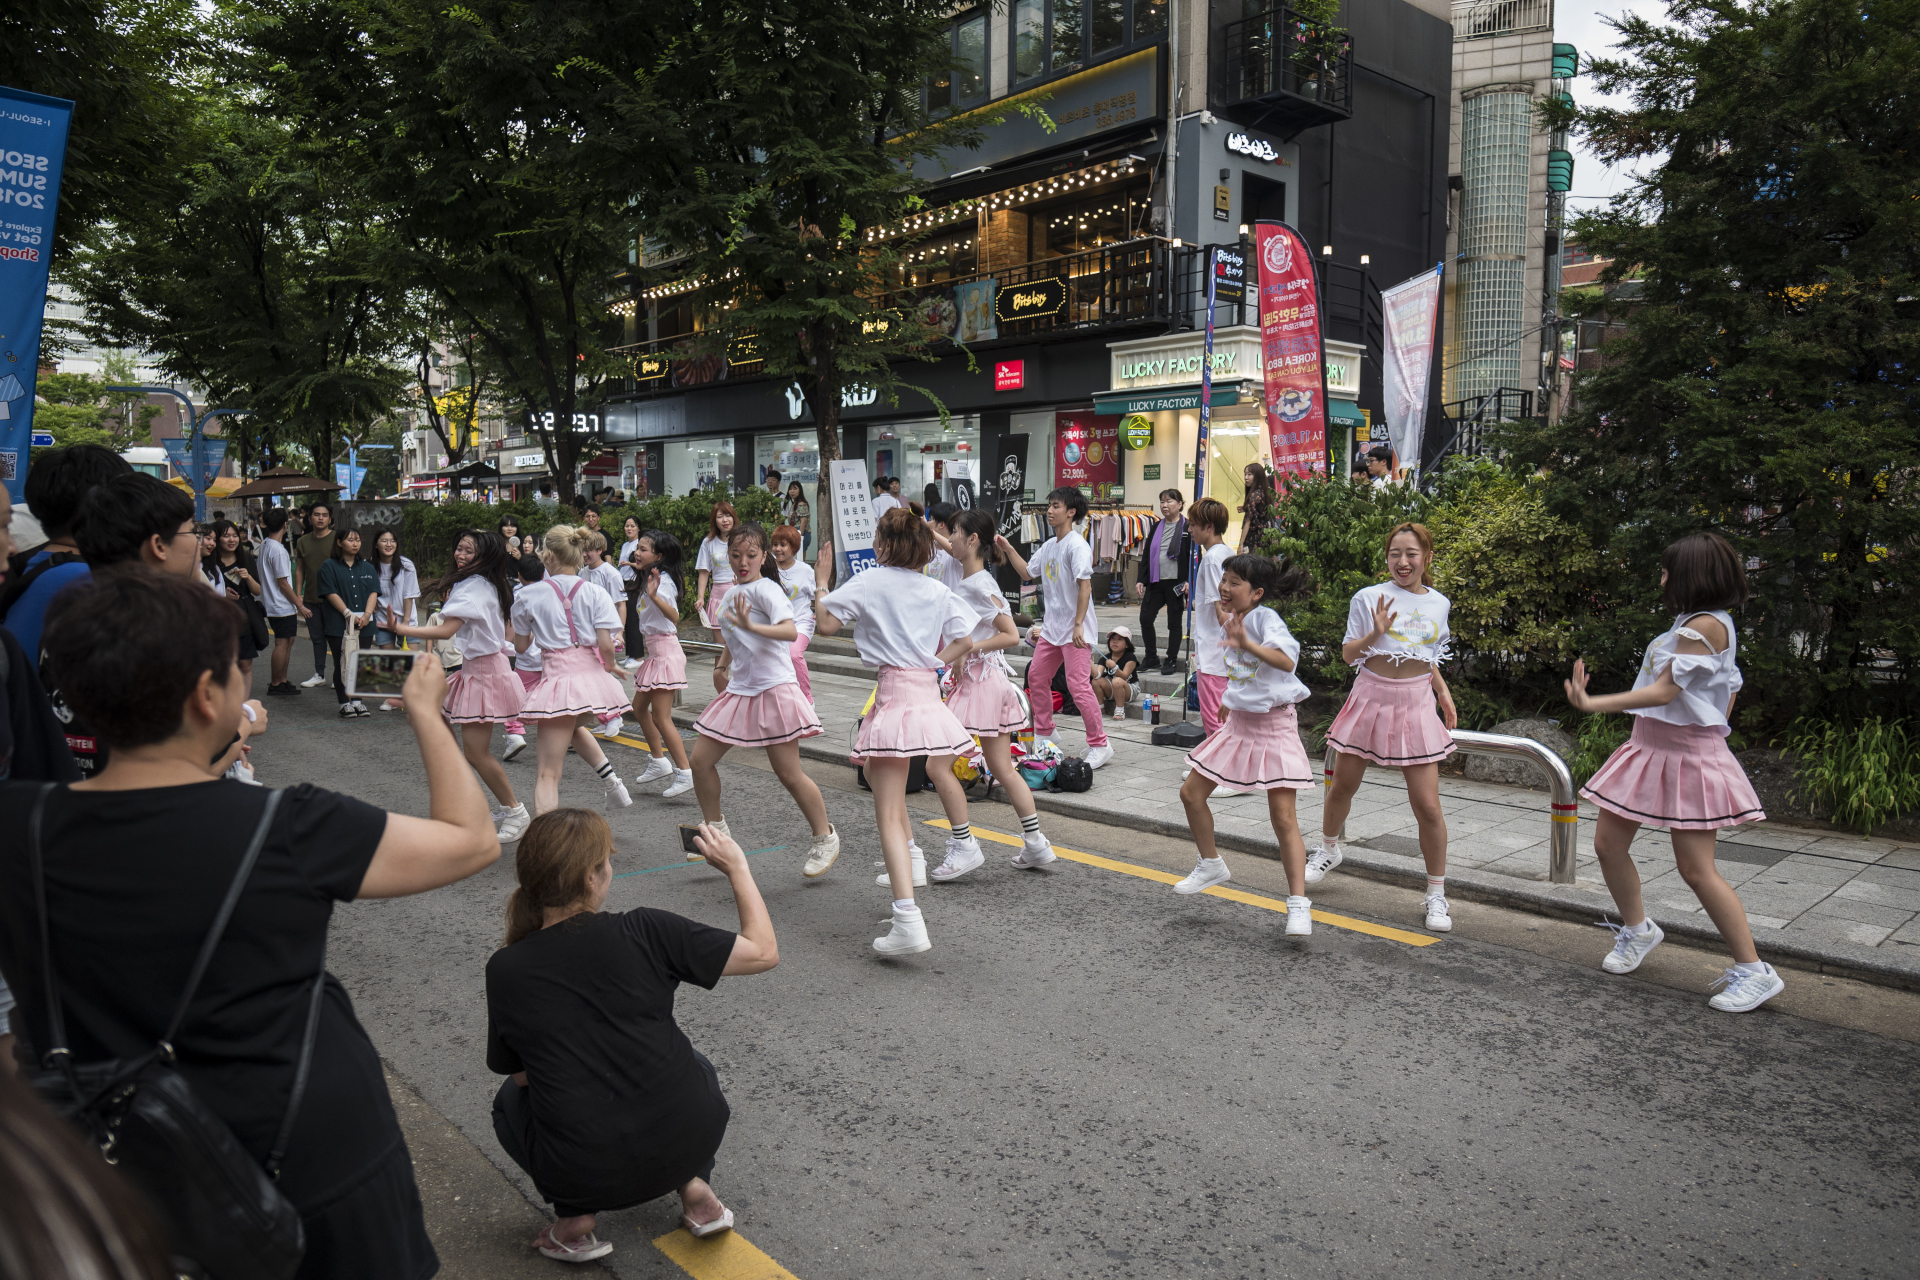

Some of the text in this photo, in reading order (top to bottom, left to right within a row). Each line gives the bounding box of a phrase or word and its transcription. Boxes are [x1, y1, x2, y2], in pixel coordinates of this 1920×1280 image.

[1093, 90, 1137, 116] 홍대직영점
[1096, 106, 1137, 129] 336.4978
[1121, 360, 1165, 379] LUCKY
[1168, 352, 1236, 373] FACTORY
[1129, 397, 1197, 411] LUCKY FACTORY
[1334, 417, 1355, 426] FACTORY
[1080, 430, 1088, 438] SK
[697, 461, 704, 469] LG
[840, 481, 862, 491] 머리를
[843, 506, 867, 516] 새로운
